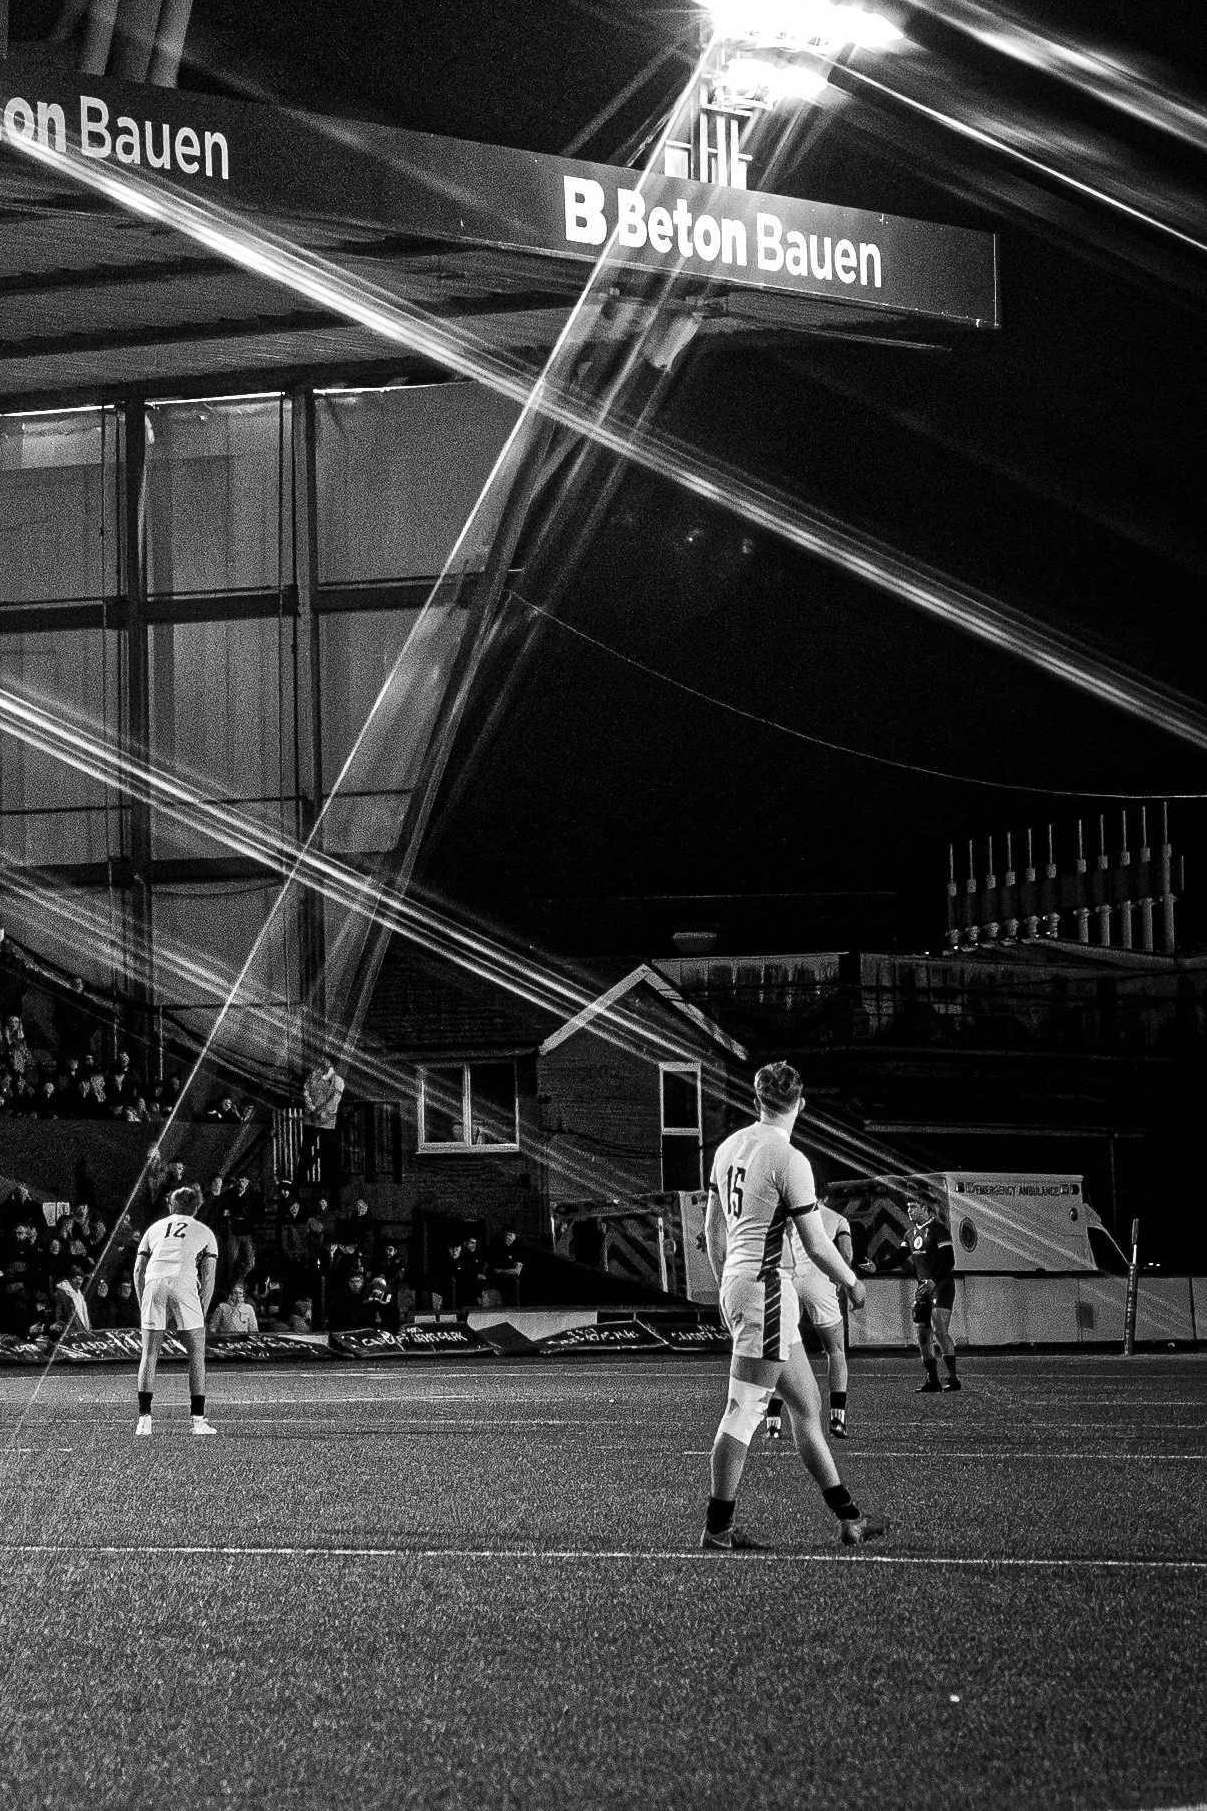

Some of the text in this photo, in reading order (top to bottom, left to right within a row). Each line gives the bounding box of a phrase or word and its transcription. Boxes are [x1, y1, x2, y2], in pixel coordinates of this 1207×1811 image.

[79, 95, 230, 181] Bauen
[616, 187, 747, 267] Beton
[756, 212, 882, 288] Bauen
[725, 1164, 747, 1220] 15
[163, 1221, 188, 1240] 12
